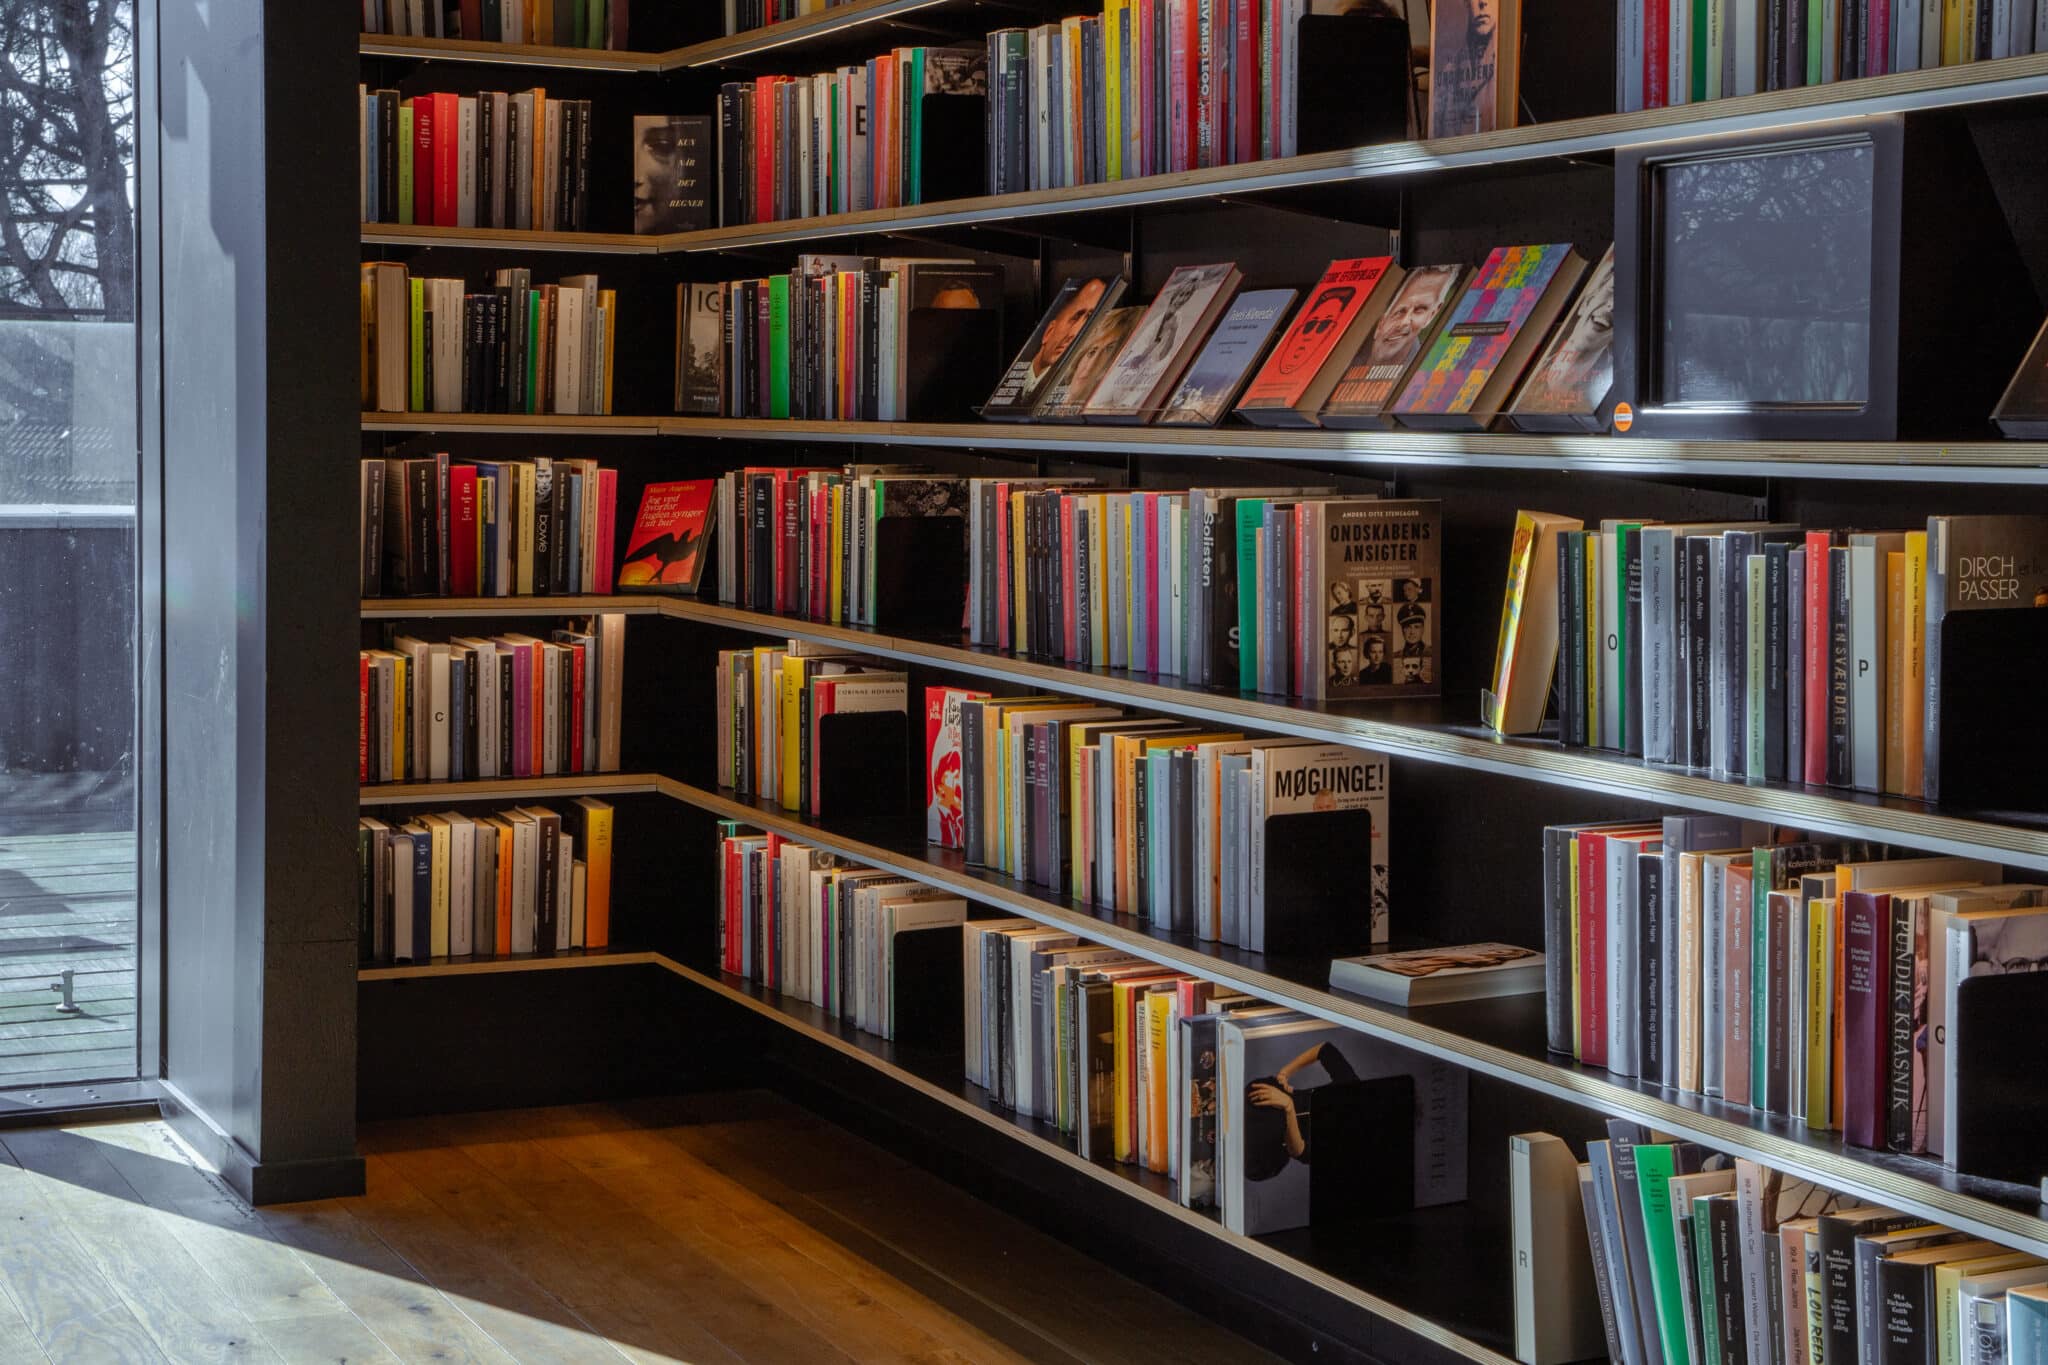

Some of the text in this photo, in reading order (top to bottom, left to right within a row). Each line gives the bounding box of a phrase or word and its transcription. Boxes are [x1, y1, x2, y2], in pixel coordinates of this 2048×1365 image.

[1201, 0, 1210, 96] LIV MED LEGO
[1040, 111, 1048, 124] K
[677, 138, 697, 147] KUN
[677, 179, 697, 188] DET
[668, 199, 704, 208] REGNER
[663, 493, 682, 504] ved
[671, 508, 705, 519] synger
[538, 513, 550, 553] bowie
[1330, 522, 1431, 542] ONDSKABENS
[1203, 511, 1215, 587] Solisten
[1343, 543, 1418, 563] ANSIGTER
[1958, 555, 2015, 578] DIRCH
[1694, 554, 1704, 620] 99.4 Olsen, Allan
[1958, 579, 2020, 601] PASSER
[1607, 633, 1618, 651] O
[1695, 636, 1704, 655] Allan
[1834, 623, 1847, 726] EN SVÆR DAG
[1858, 659, 1869, 678] P
[838, 687, 905, 697] CORINNE HOFMANN
[434, 710, 445, 722] C
[1274, 764, 1385, 800] MØGUNGE!
[1893, 917, 1912, 1112] PUNDIK KRASNIK
[1518, 1250, 1528, 1268] R
[1790, 1245, 1798, 1264] 99.4
[1831, 1280, 1847, 1289] Lund
[1890, 1305, 1909, 1315] Keith
[1807, 1286, 1824, 1365] LOU REED
[1890, 1316, 1909, 1326] Keith
